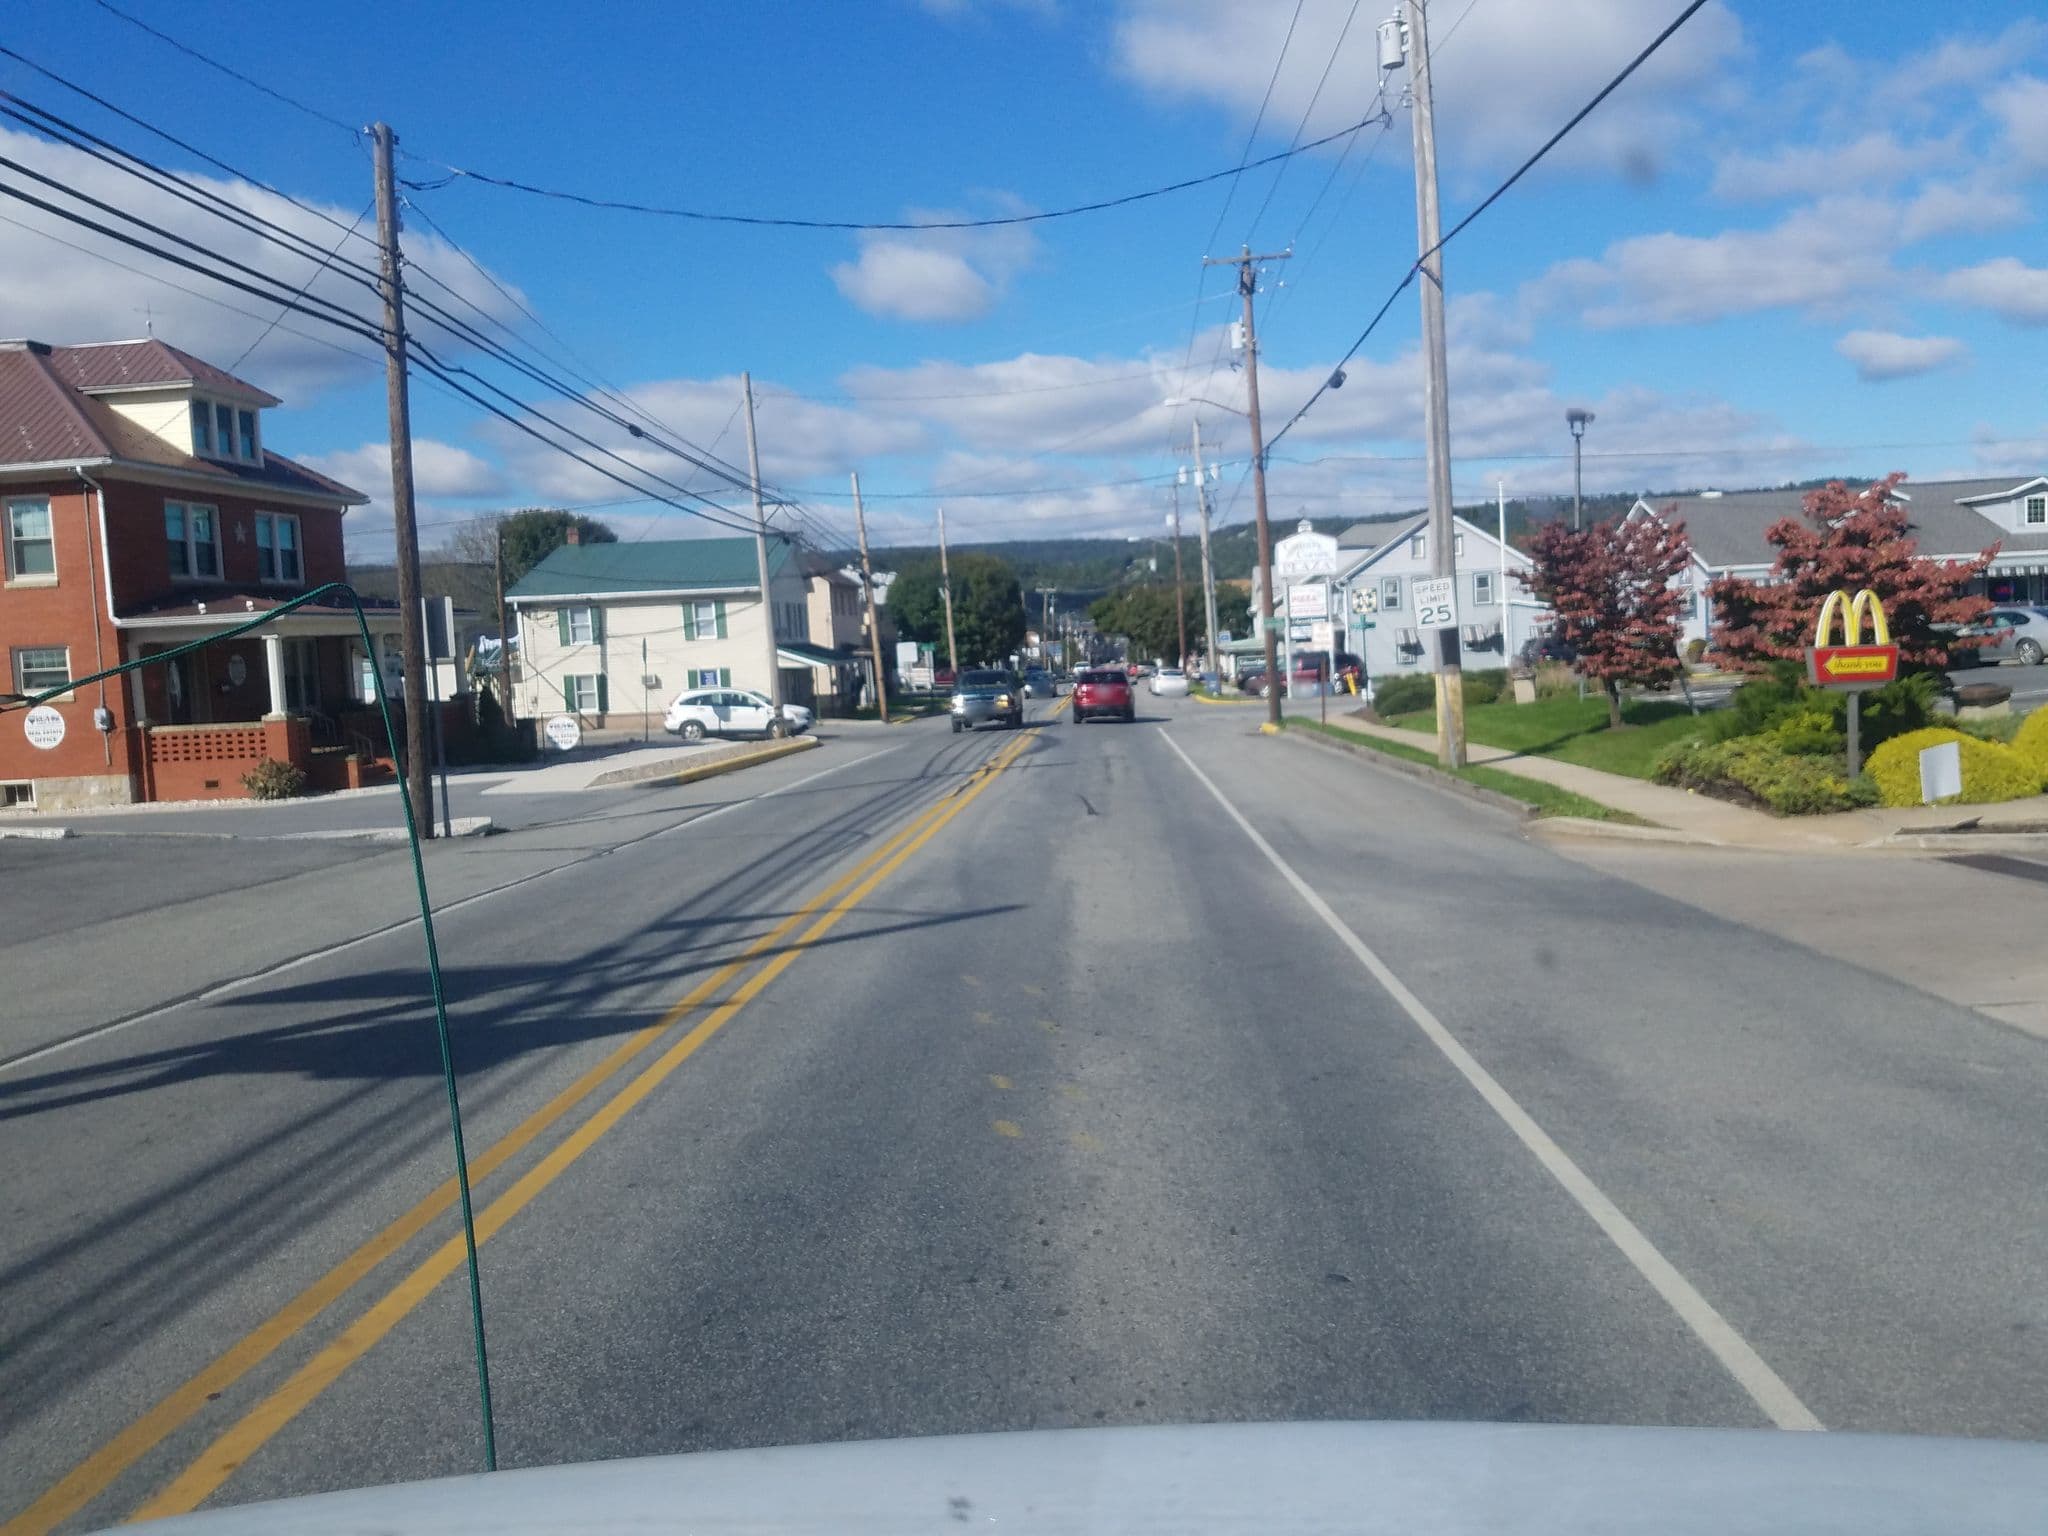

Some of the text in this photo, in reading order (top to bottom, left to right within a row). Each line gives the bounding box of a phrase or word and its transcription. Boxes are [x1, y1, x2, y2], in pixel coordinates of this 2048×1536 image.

[1415, 582, 1449, 594] SPEED
[1420, 593, 1447, 605] LIMIT
[1420, 604, 1451, 625] 25
